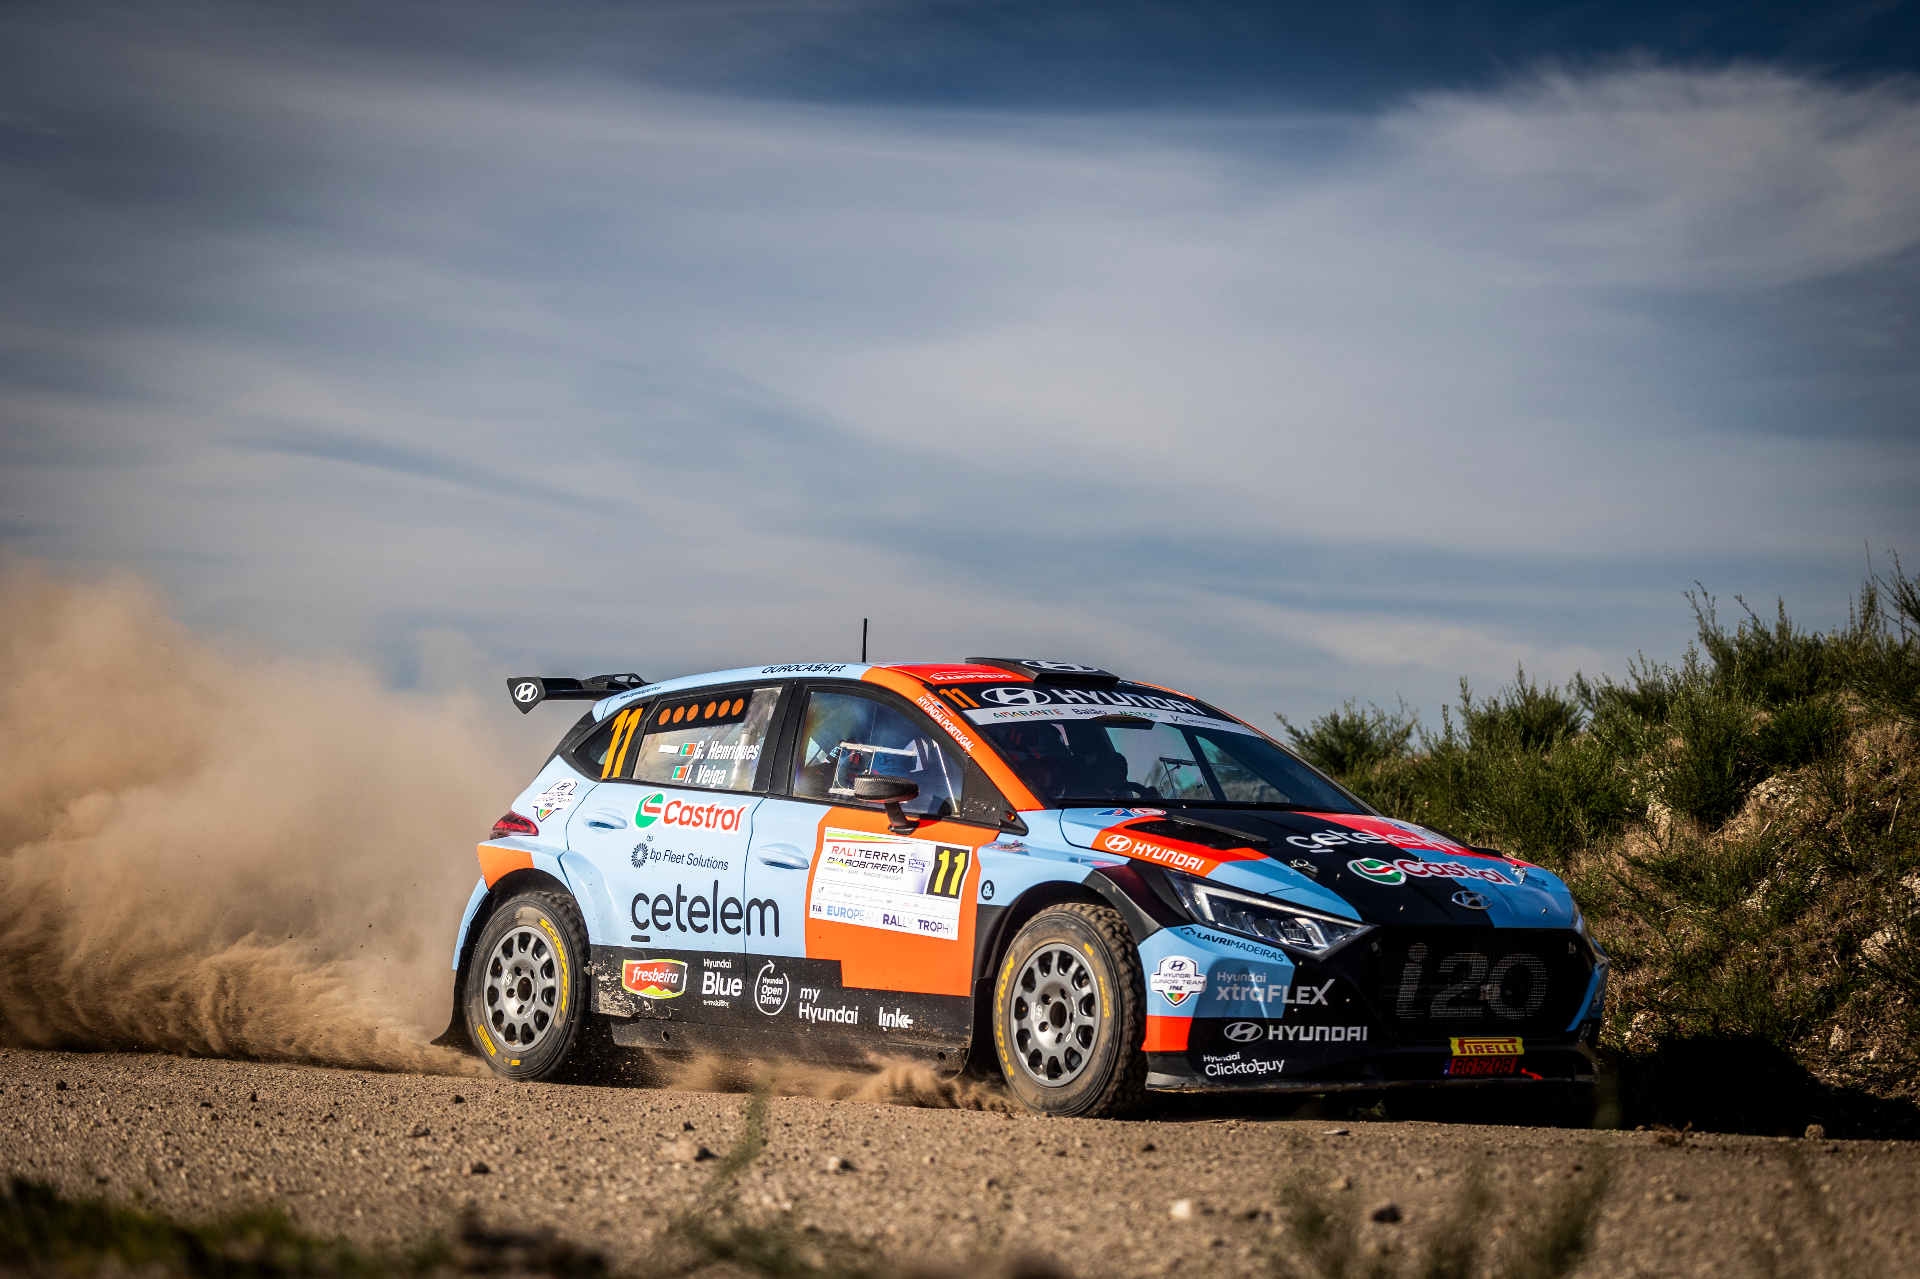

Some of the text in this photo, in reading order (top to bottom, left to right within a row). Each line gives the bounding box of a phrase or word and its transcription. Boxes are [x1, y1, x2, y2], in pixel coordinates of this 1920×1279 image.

[939, 688, 1207, 716] 11 HYUNDAI
[916, 696, 975, 752] HYUNDAI PORTUGAL
[601, 707, 643, 779] 11
[693, 740, 760, 766] G. Henriques
[684, 765, 727, 788] I. Veiga
[663, 800, 747, 832] Castrol
[1286, 829, 1461, 853] cetelem
[650, 848, 729, 871] bp Fleet Solutions
[831, 845, 906, 864] RALI TERRAS
[1132, 842, 1205, 871] HYUNDAI
[933, 849, 966, 896] 11
[1396, 859, 1514, 885] Castrol
[631, 880, 780, 942] cetelem
[827, 905, 879, 923] EUROPEAN
[882, 914, 914, 929] RALLY
[918, 919, 956, 934] TROPHY
[1196, 932, 1285, 963] LAVRIMADEIRAS
[632, 966, 679, 984] fresbeira
[703, 958, 732, 969] Hyundai
[702, 971, 743, 996] Blue
[762, 977, 783, 985] Hyundai
[1217, 971, 1267, 984] Hyundai
[1396, 942, 1549, 1020] i20
[760, 995, 781, 1005] Drive
[761, 985, 783, 996] Open
[800, 987, 820, 1003] my
[1216, 979, 1336, 1006] xtraFLEX
[799, 1002, 859, 1025] Hyundai
[1268, 1025, 1368, 1042] HYUNDAI
[1203, 1052, 1241, 1063] Hyundai
[1458, 1038, 1518, 1054] PIRELLI
